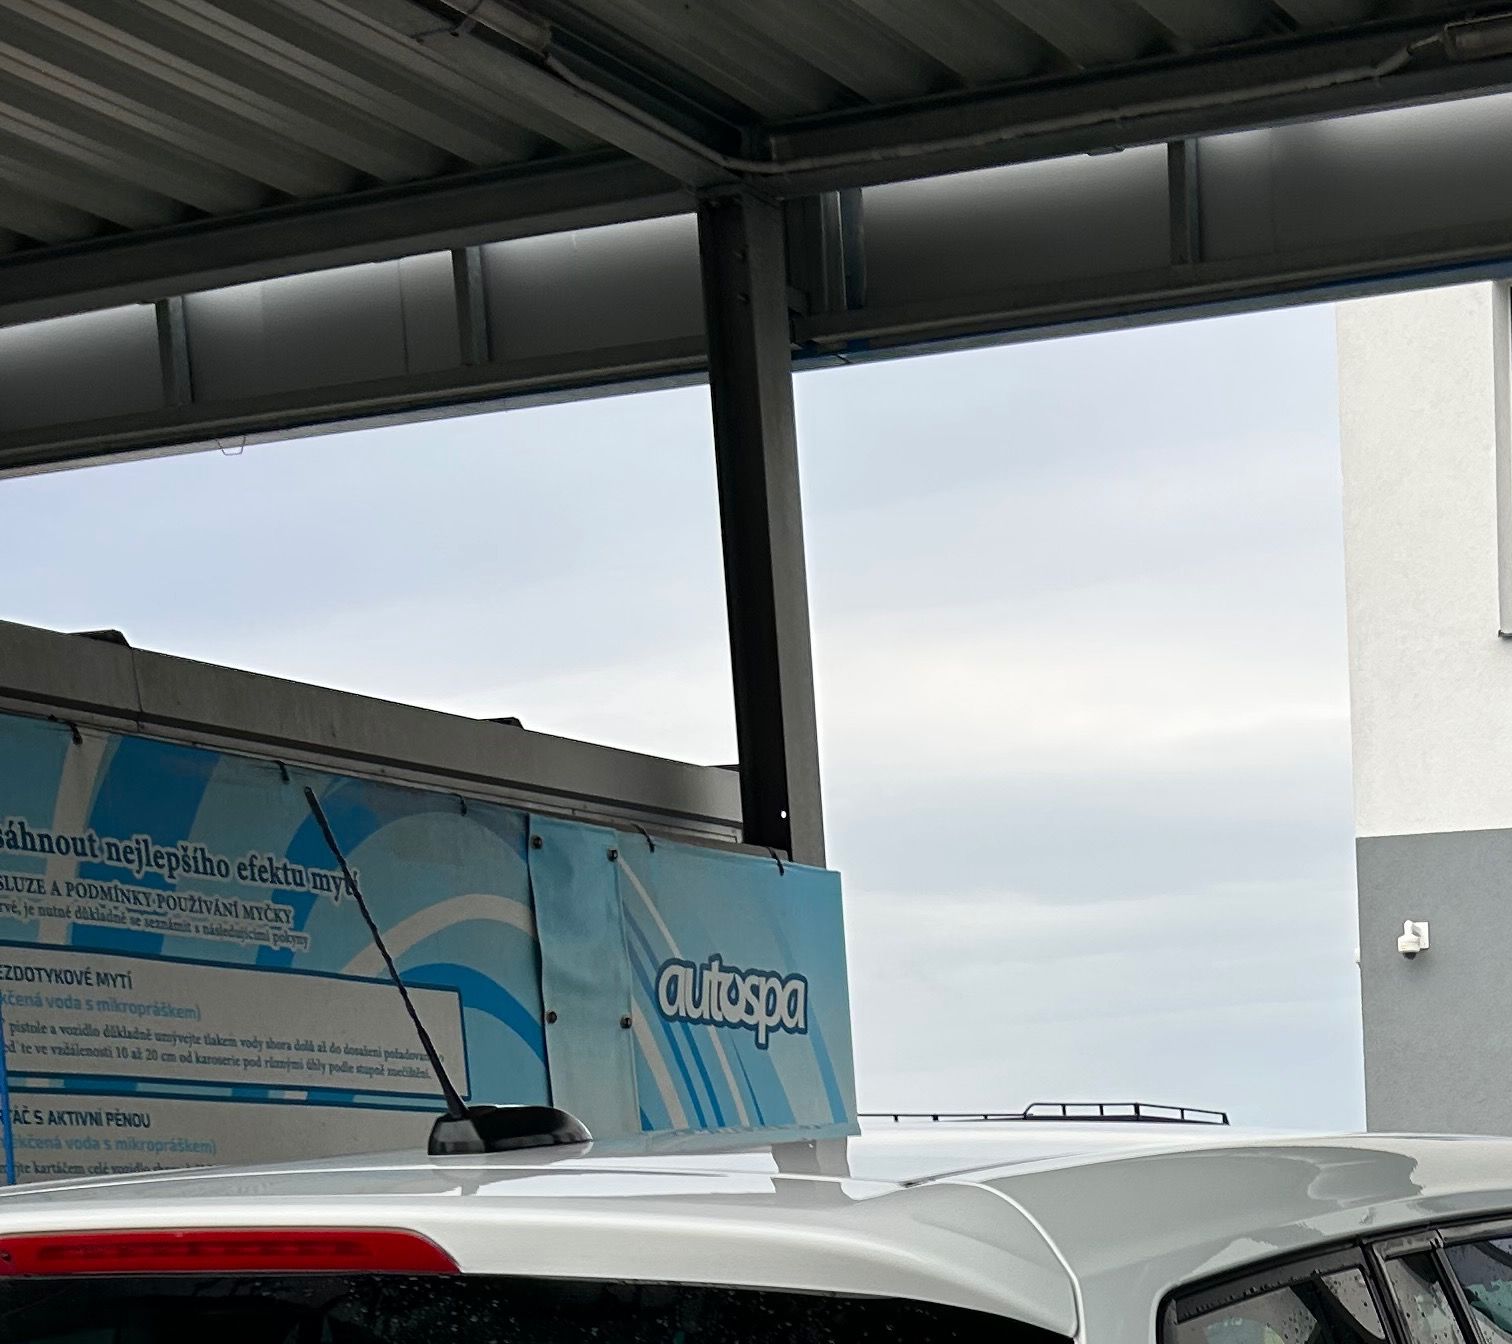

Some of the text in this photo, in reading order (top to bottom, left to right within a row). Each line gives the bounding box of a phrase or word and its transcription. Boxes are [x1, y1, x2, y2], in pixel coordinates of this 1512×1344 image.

[105, 838, 230, 879] nejlepšího
[237, 855, 306, 887] efektu
[51, 881, 62, 897] A
[65, 881, 153, 906] PODMÍNKY
[157, 892, 239, 918] POUŽÍVÁNÍ
[242, 903, 293, 925] MYČKY
[96, 970, 133, 990] MYTÍ
[46, 994, 82, 1010] voda
[85, 1000, 93, 1011] s
[97, 997, 202, 1021] mikropráškem)
[656, 955, 808, 1049] autospa
[115, 1046, 129, 1060] 10
[145, 1047, 158, 1061] 20
[161, 1051, 176, 1062] cm
[179, 1051, 193, 1064] od
[34, 1110, 44, 1126] S
[48, 1107, 103, 1127] AKTIVNÍ
[106, 1108, 151, 1129] PĚNOU
[66, 1137, 100, 1151] voda
[104, 1139, 111, 1150] s
